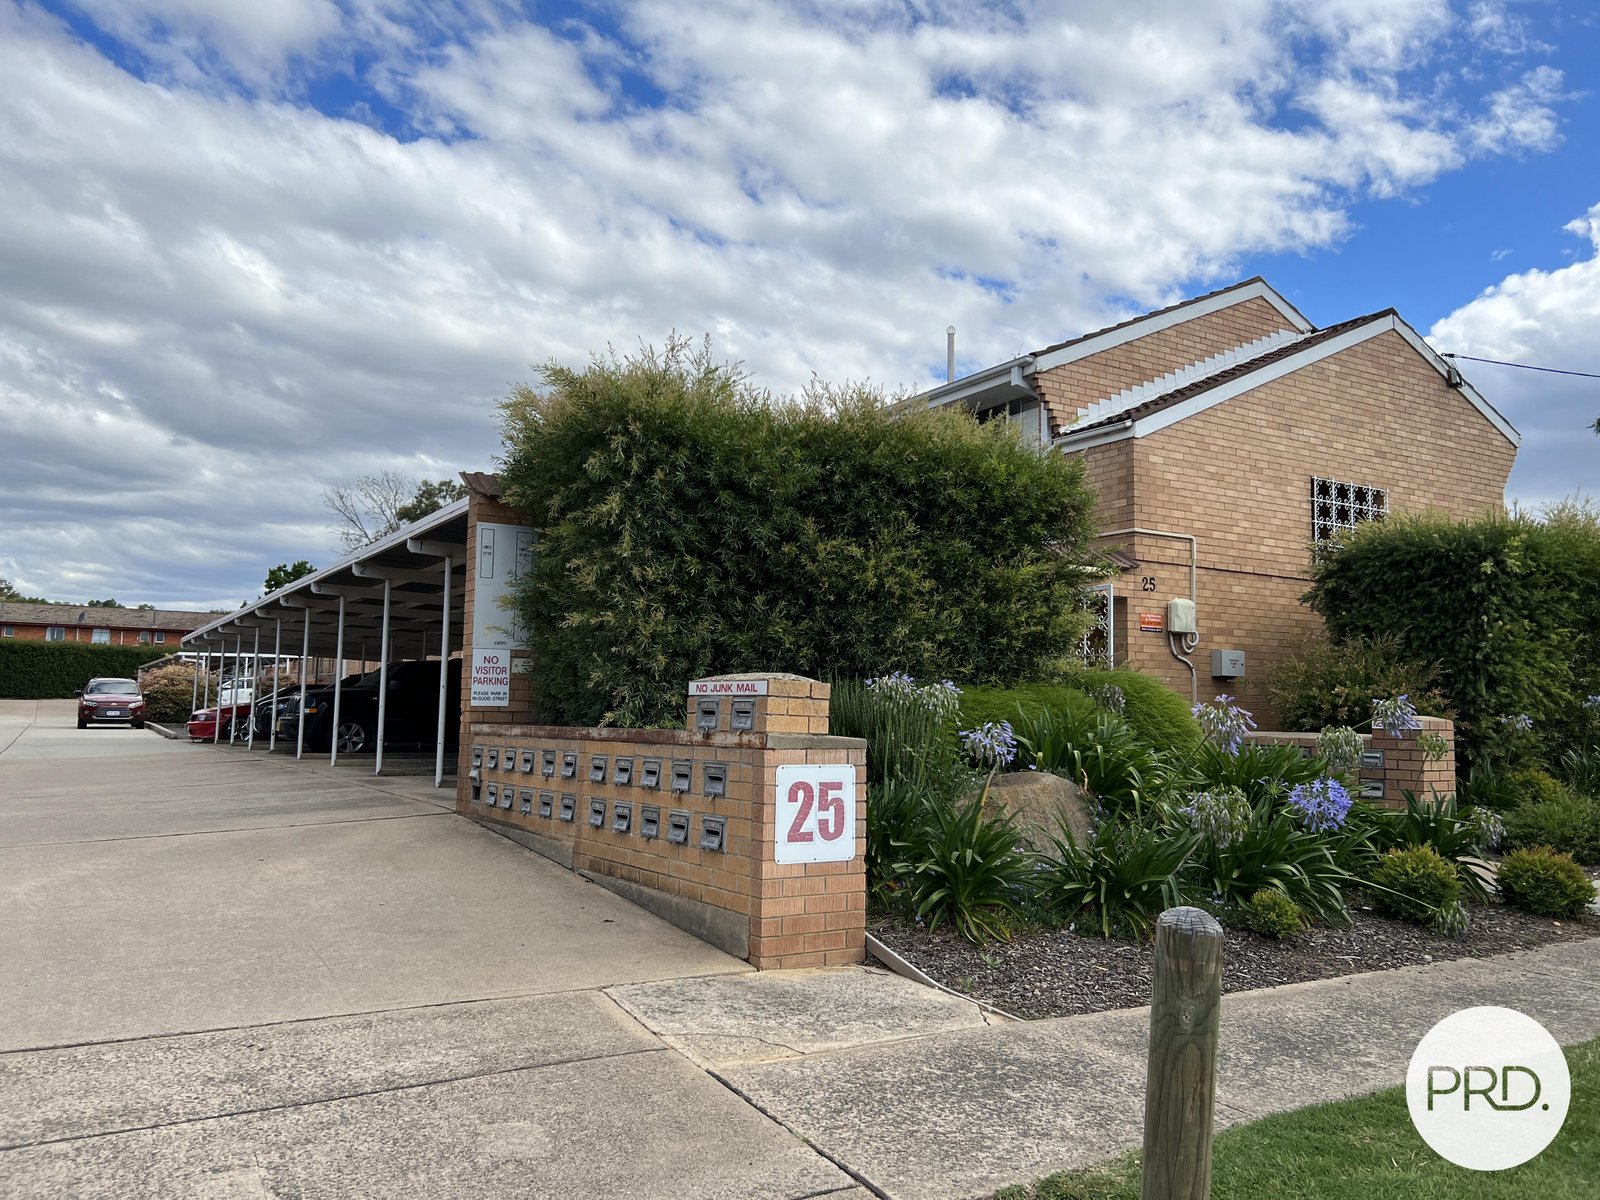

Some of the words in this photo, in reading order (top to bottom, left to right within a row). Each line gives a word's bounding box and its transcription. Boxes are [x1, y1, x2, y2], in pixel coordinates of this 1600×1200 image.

[360, 565, 367, 575] 2
[316, 584, 322, 592] 3
[1141, 577, 1156, 592] 25
[483, 656, 499, 664] NO
[475, 666, 507, 675] VISITOR
[473, 677, 508, 686] PARKING
[696, 684, 708, 693] NO
[710, 684, 733, 692] JUNK
[736, 683, 758, 692] MAIL
[787, 781, 844, 843] 25
